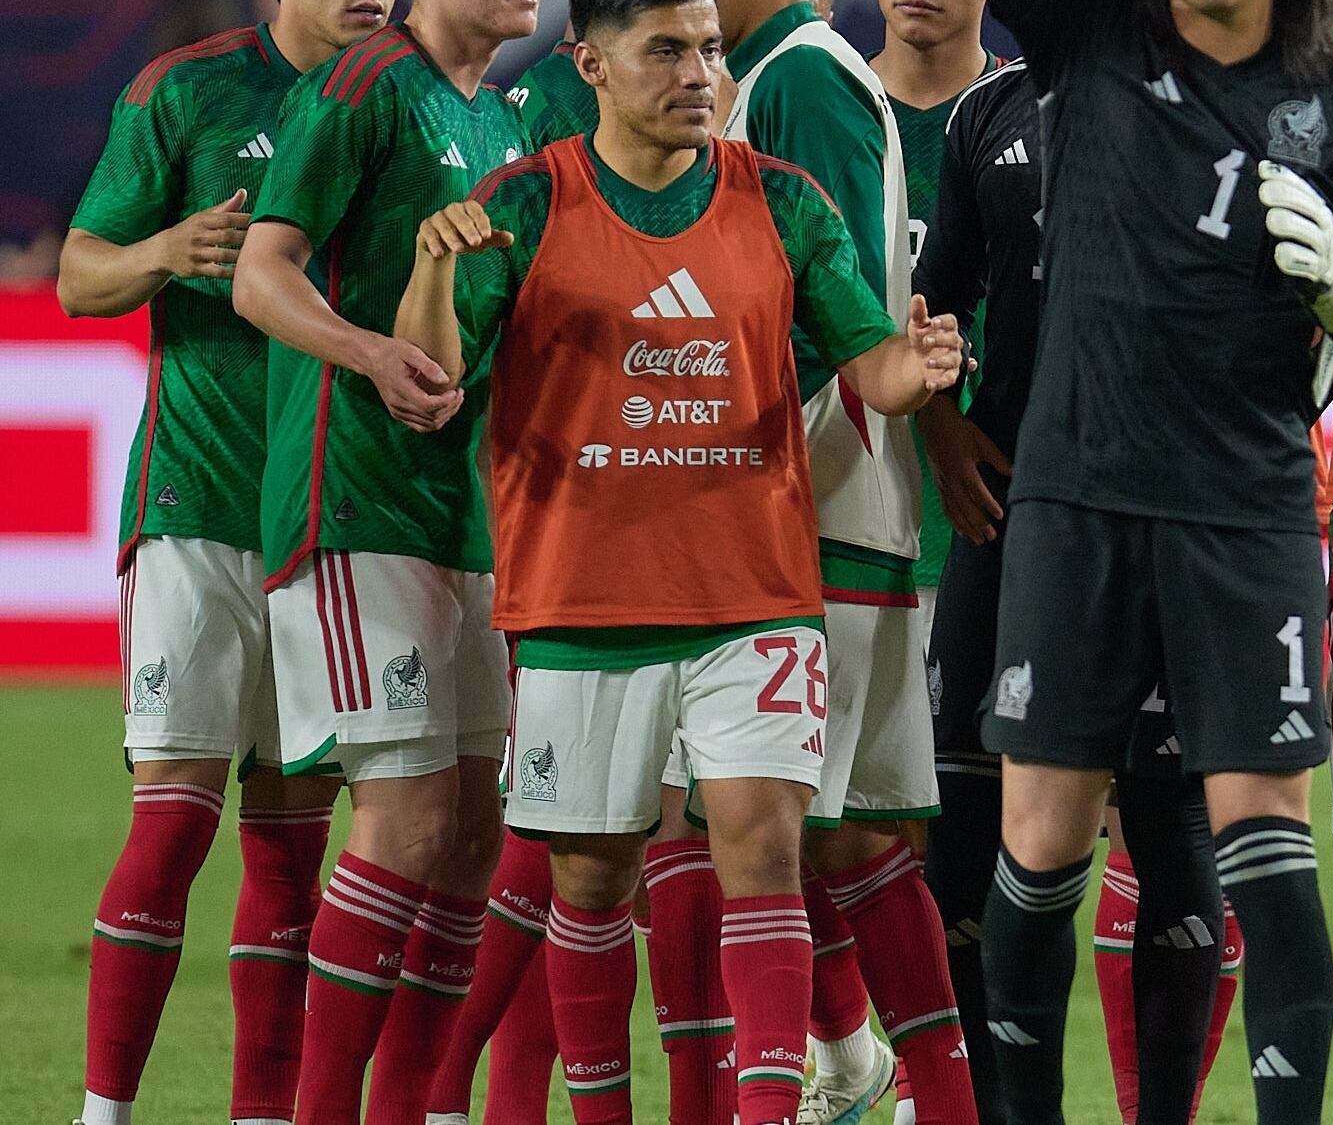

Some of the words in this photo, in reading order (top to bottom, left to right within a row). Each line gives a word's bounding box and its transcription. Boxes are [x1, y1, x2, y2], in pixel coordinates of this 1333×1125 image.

[1197, 149, 1246, 241] 1
[623, 340, 731, 377] Coca-Cola
[657, 399, 726, 424] AT&T
[620, 447, 763, 466] BANORTE
[1277, 616, 1311, 704] 1
[136, 705, 166, 715] MÉXICO
[389, 697, 426, 709] MÉXICO
[523, 788, 554, 800] MÉXICO
[121, 911, 181, 930] MÉXICO
[566, 1059, 621, 1075] MÉXICO
